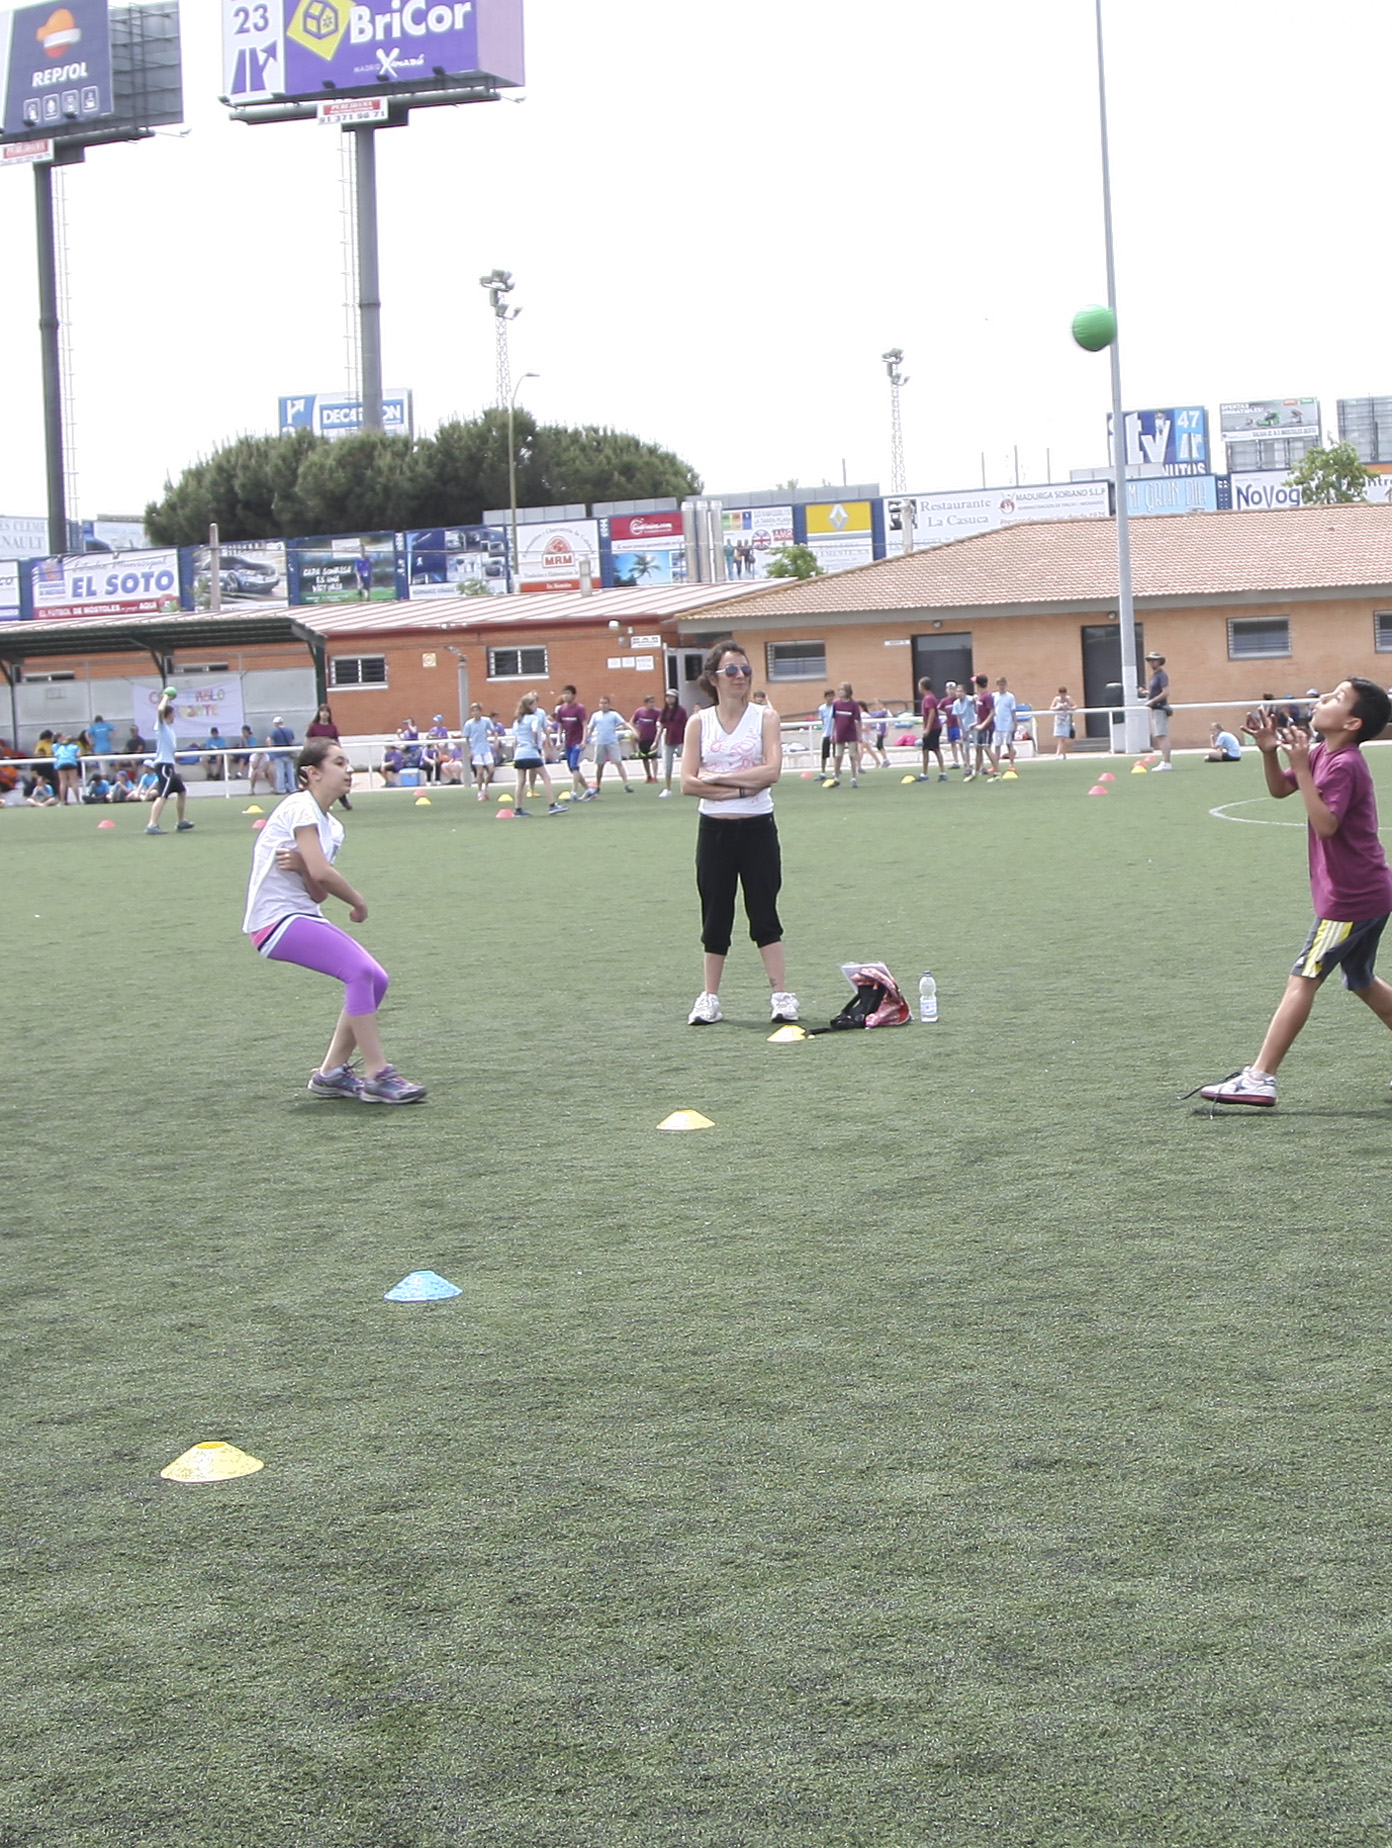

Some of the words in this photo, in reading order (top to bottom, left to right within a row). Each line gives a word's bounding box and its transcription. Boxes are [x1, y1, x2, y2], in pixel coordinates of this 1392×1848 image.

[233, 3, 269, 35] 23
[350, 0, 471, 43] BriCor
[32, 62, 88, 87] REPSOL
[1178, 411, 1200, 428] 47
[920, 499, 992, 512] Restaurante
[928, 516, 943, 527] La
[947, 515, 989, 526] Casuca
[545, 556, 572, 566] MRM
[71, 576, 97, 597] EL
[104, 569, 174, 595] SOTO
